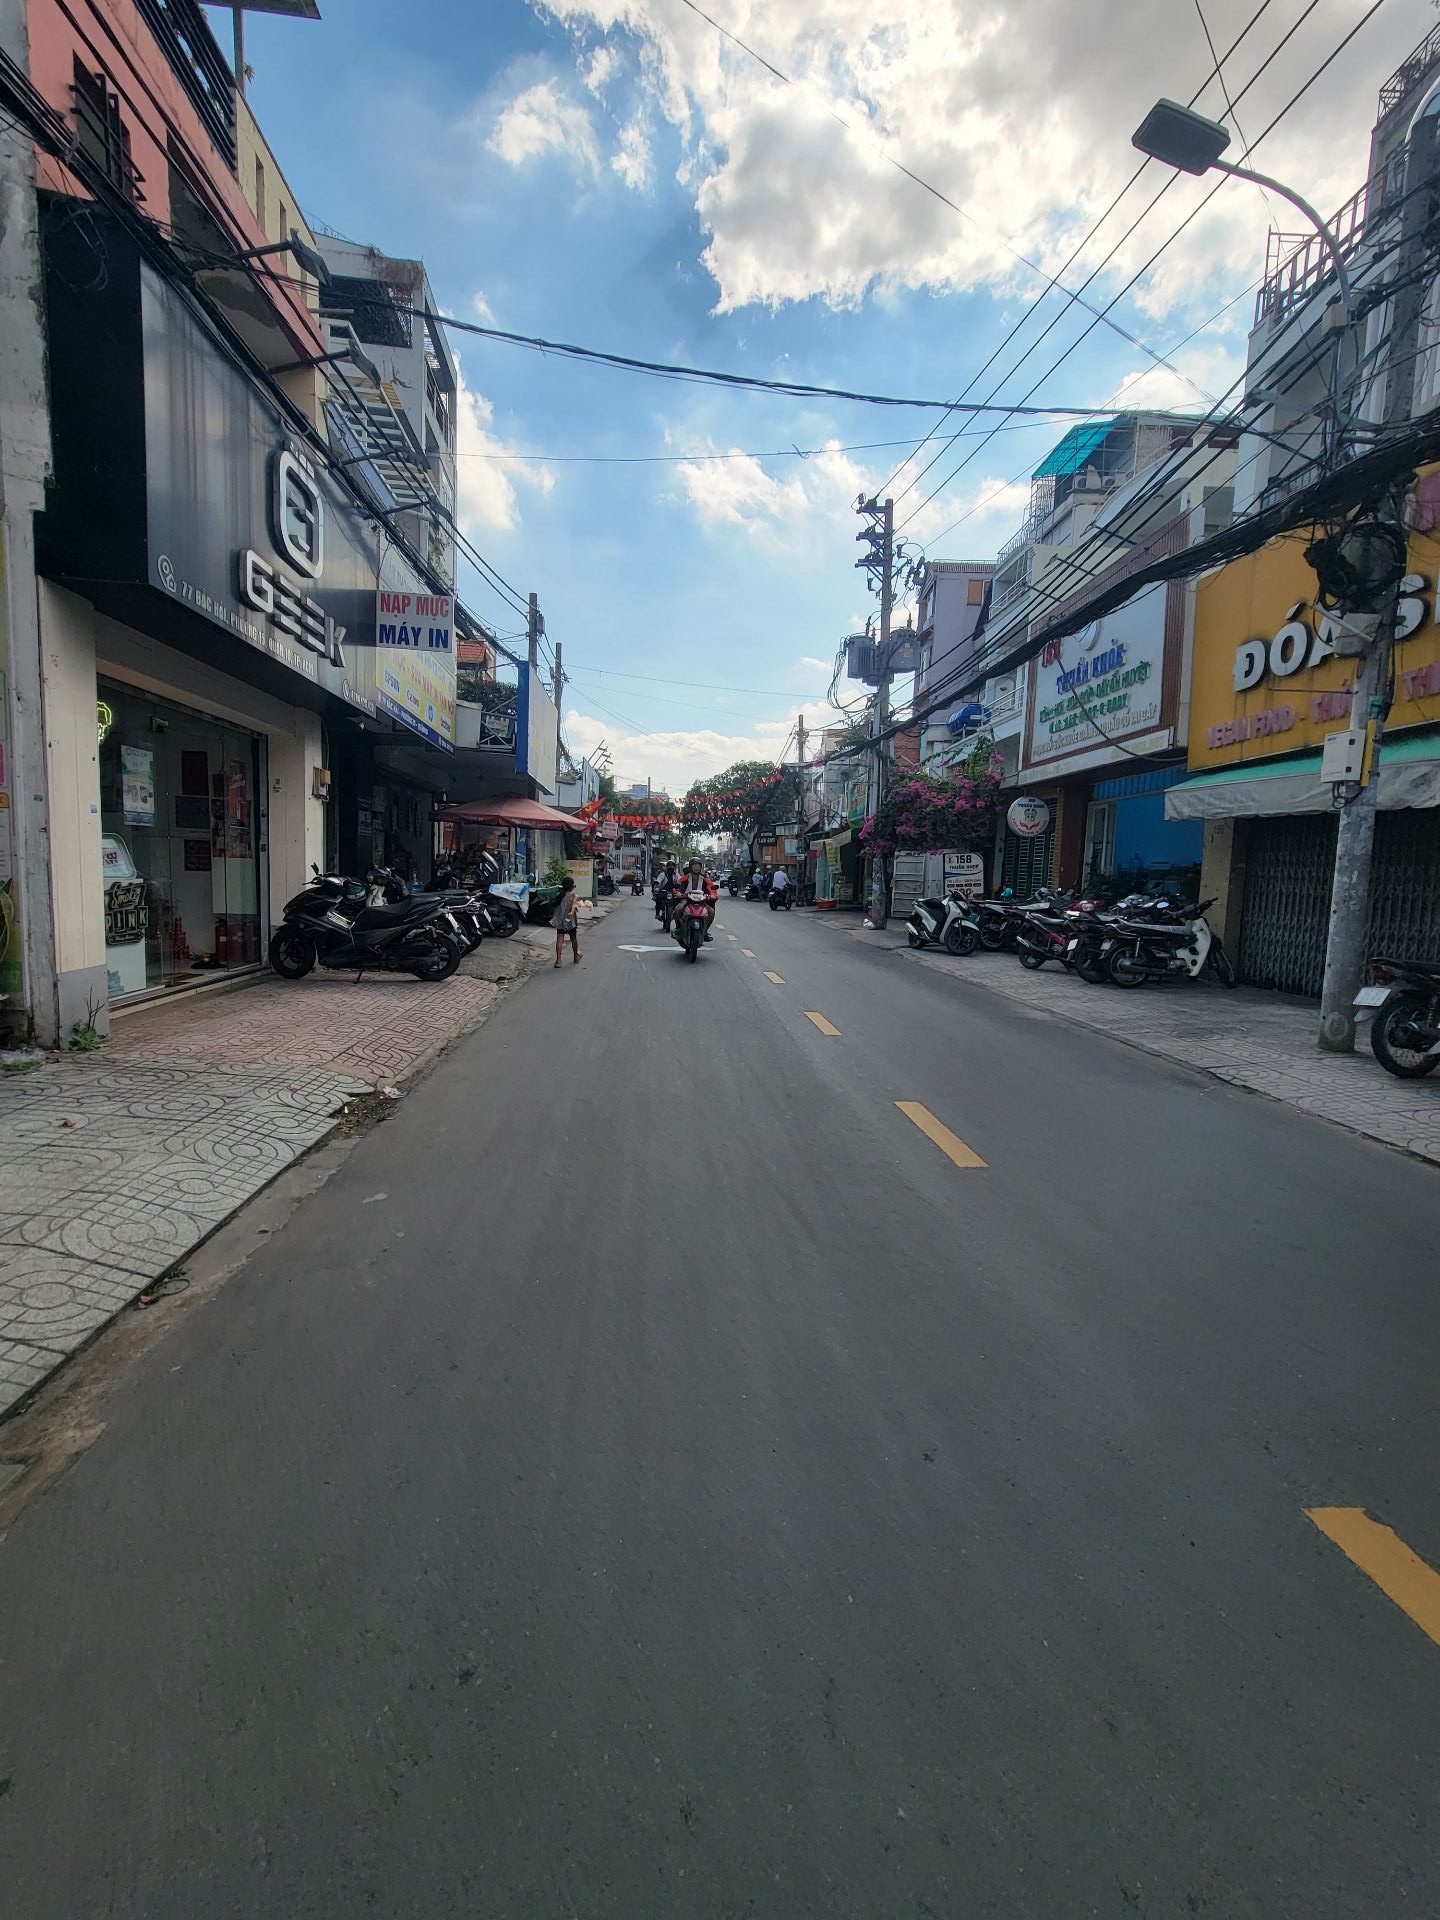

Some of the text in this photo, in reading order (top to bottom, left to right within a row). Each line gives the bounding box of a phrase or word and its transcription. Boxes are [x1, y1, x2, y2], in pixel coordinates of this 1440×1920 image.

[181, 581, 193, 600] 77
[245, 549, 347, 668] GEEK
[380, 592, 450, 621] NẠP MỰC
[379, 622, 449, 648] MÁY IN
[1232, 602, 1344, 692] ĐÓA
[955, 854, 972, 864] 158
[106, 909, 146, 932] PINK
